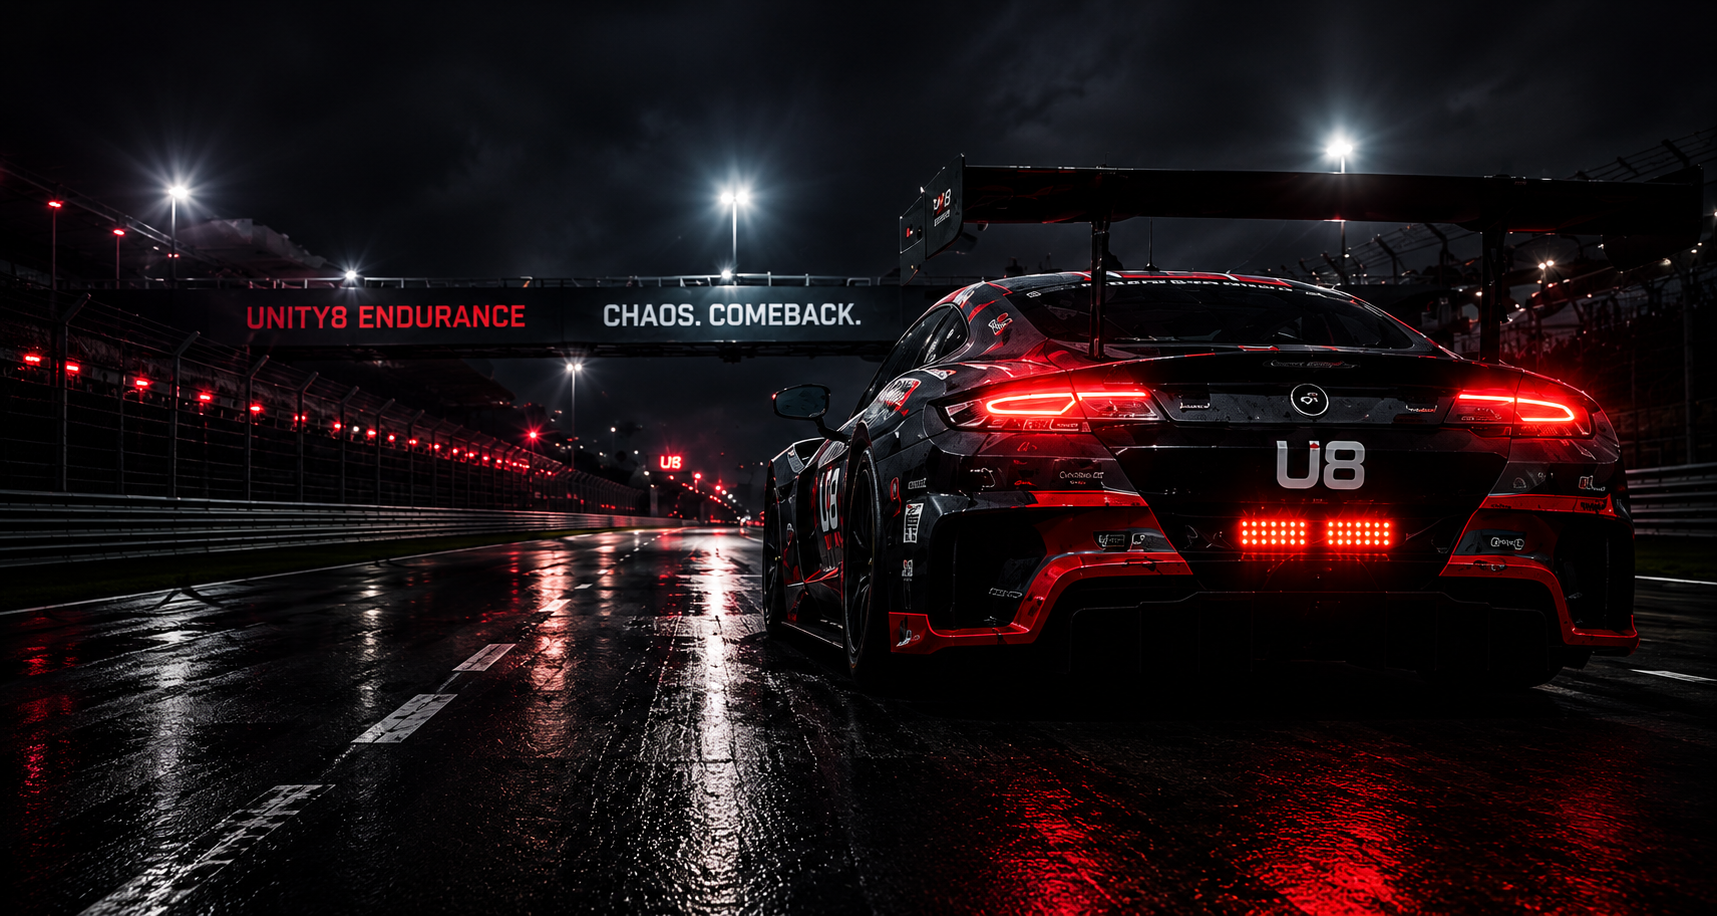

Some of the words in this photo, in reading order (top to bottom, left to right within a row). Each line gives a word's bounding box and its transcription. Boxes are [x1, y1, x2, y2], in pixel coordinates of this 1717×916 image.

[247, 305, 348, 330] UNITY8
[358, 304, 526, 328] ENDURANCE
[603, 303, 702, 327] CHAOS.
[708, 302, 862, 326] COMEBACK.
[1276, 440, 1366, 490] U8
[819, 467, 840, 533] U8
